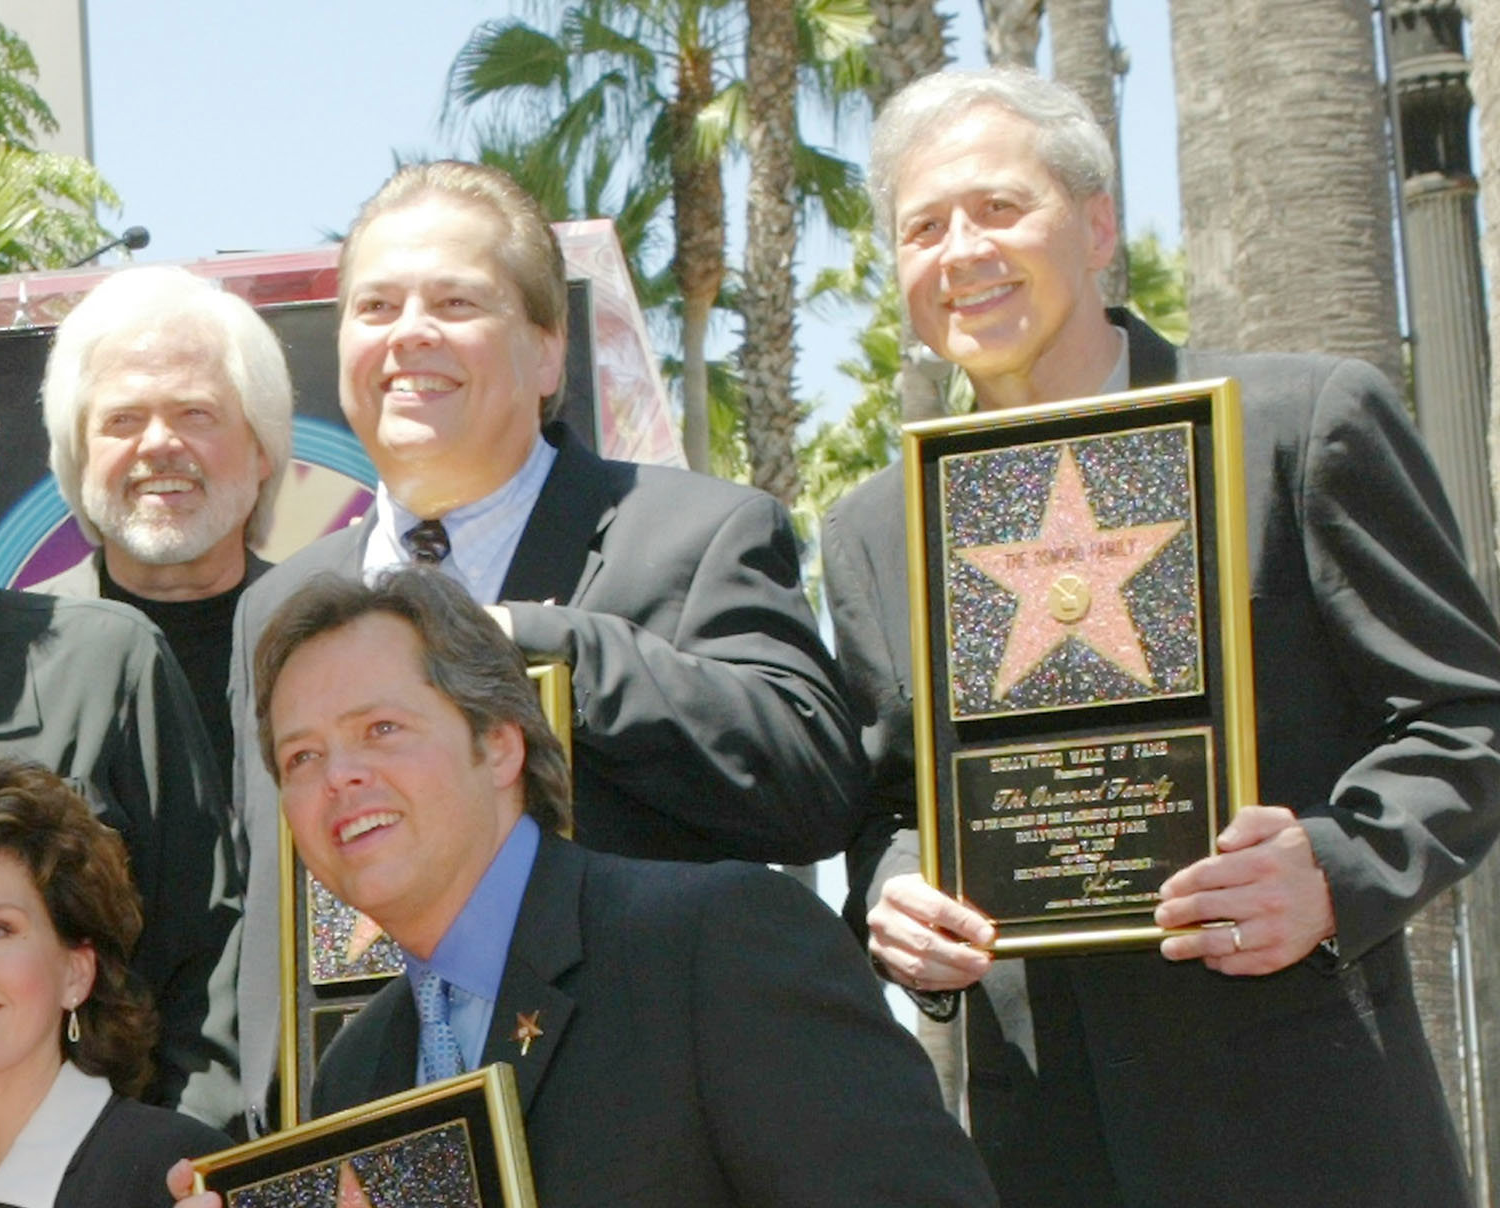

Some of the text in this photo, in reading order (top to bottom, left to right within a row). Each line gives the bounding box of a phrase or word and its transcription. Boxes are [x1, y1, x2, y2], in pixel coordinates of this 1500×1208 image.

[1004, 551, 1028, 569] THE
[1069, 747, 1106, 764] WALK
[1133, 740, 1169, 758] FAME
[991, 788, 1028, 812] The
[1030, 779, 1108, 808] Osmond
